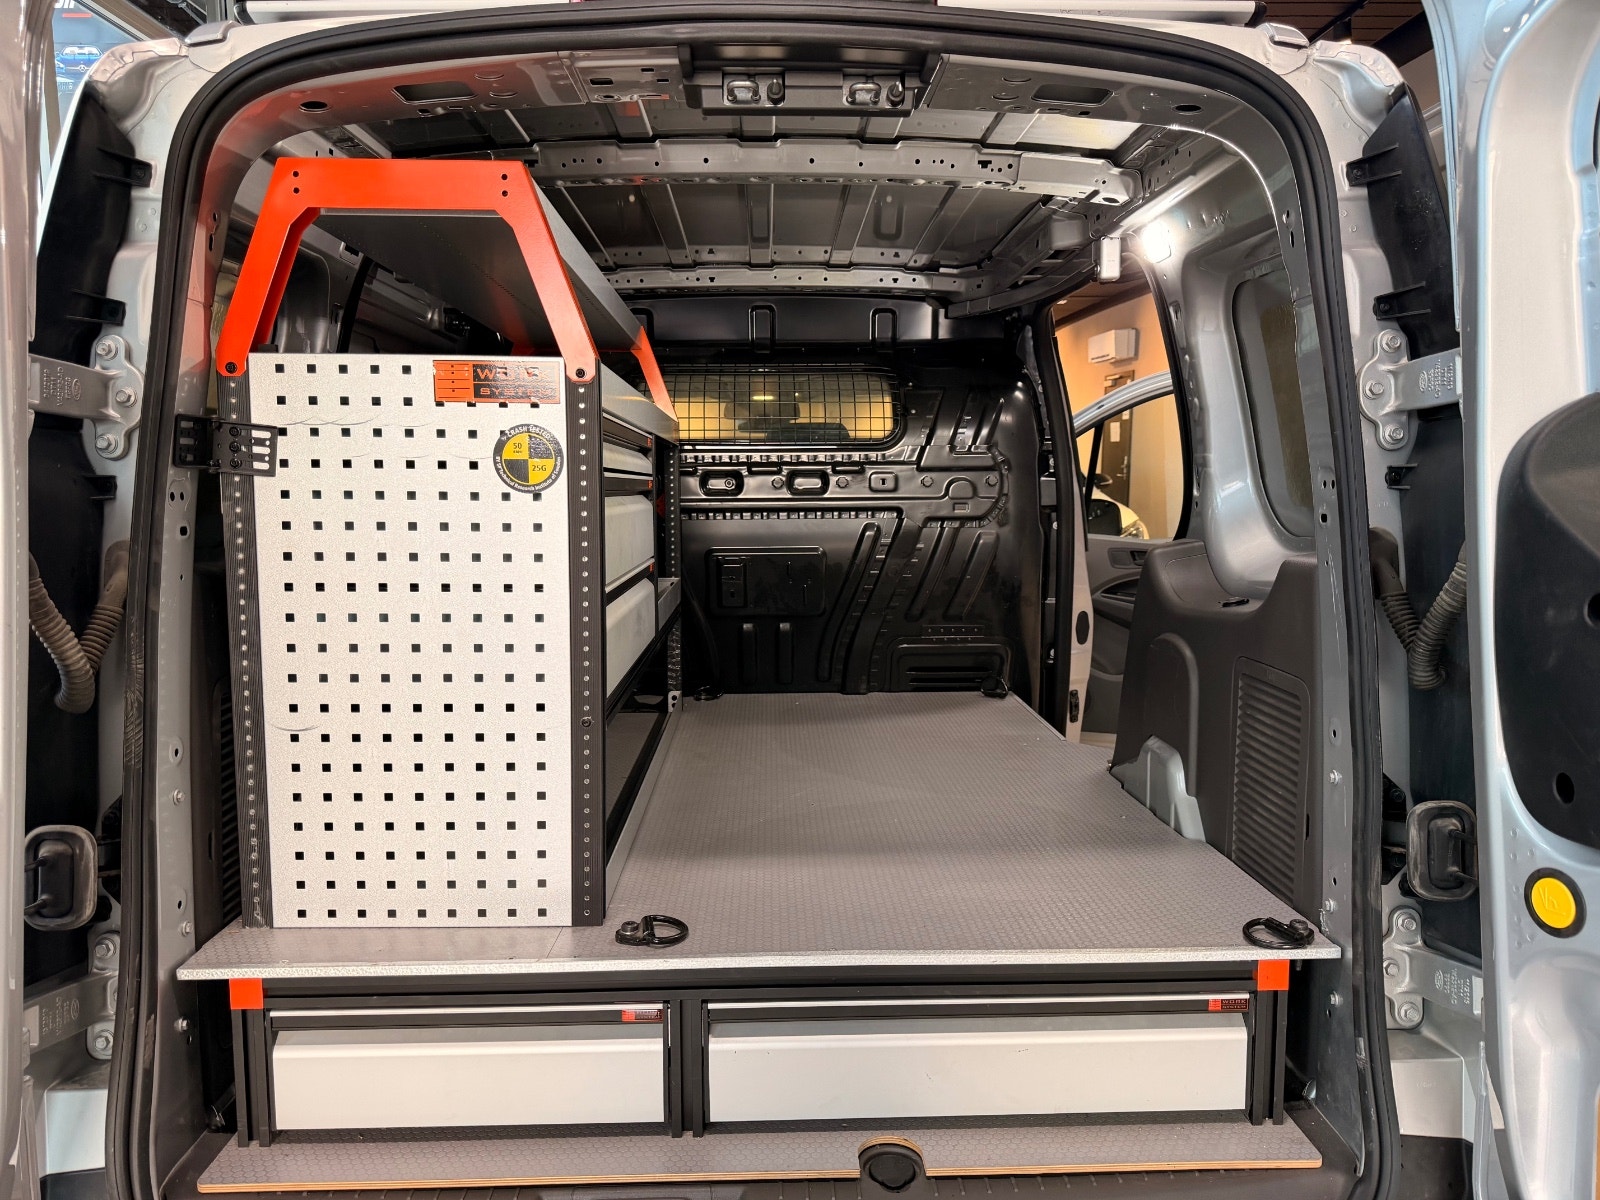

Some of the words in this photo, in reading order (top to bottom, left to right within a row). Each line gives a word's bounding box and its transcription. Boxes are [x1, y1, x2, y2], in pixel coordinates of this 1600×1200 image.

[506, 425, 527, 437] CRASH
[513, 442, 523, 450] 50
[531, 464, 547, 472] 25G
